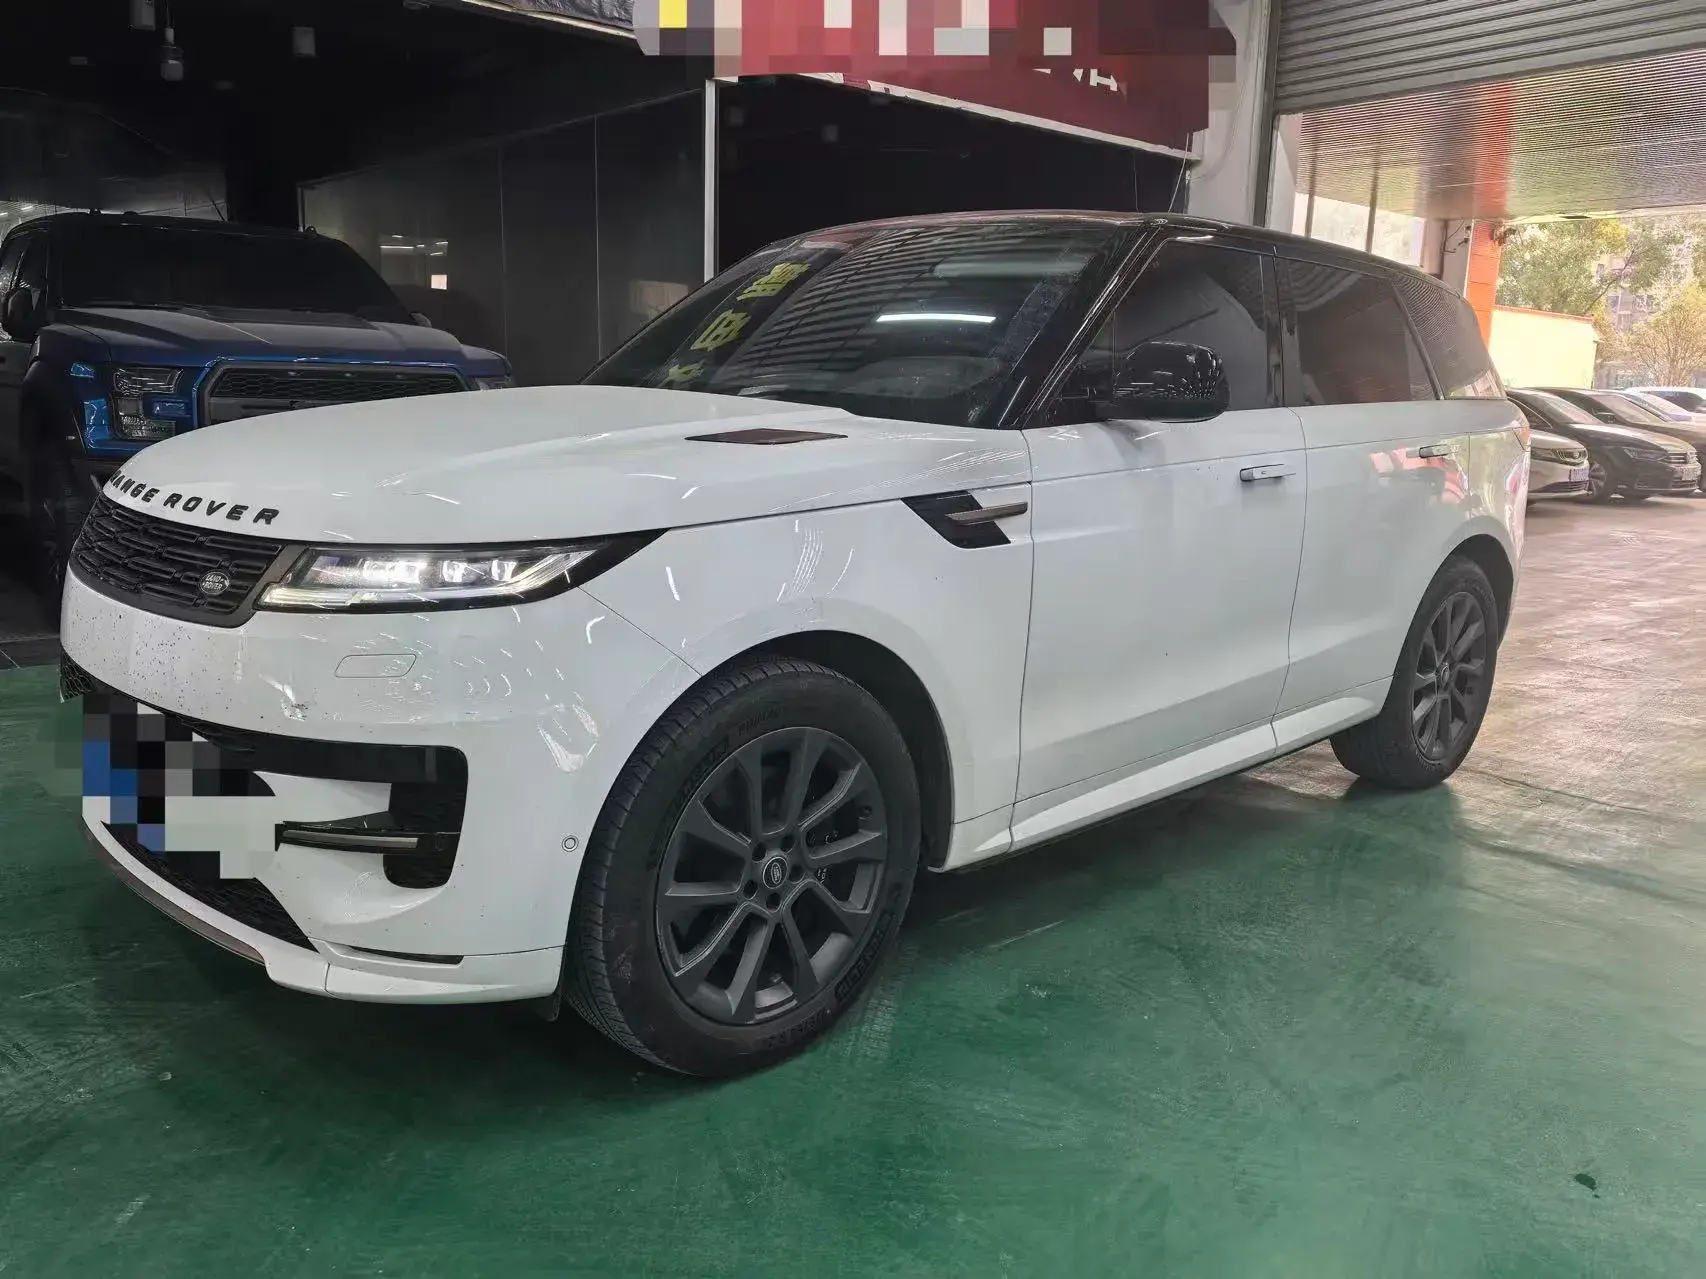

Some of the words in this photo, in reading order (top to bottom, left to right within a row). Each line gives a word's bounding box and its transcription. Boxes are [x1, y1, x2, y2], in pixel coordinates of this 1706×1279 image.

[163, 493, 280, 525] ROVER
[205, 574, 222, 583] LAND
[203, 581, 223, 590] ROVER
